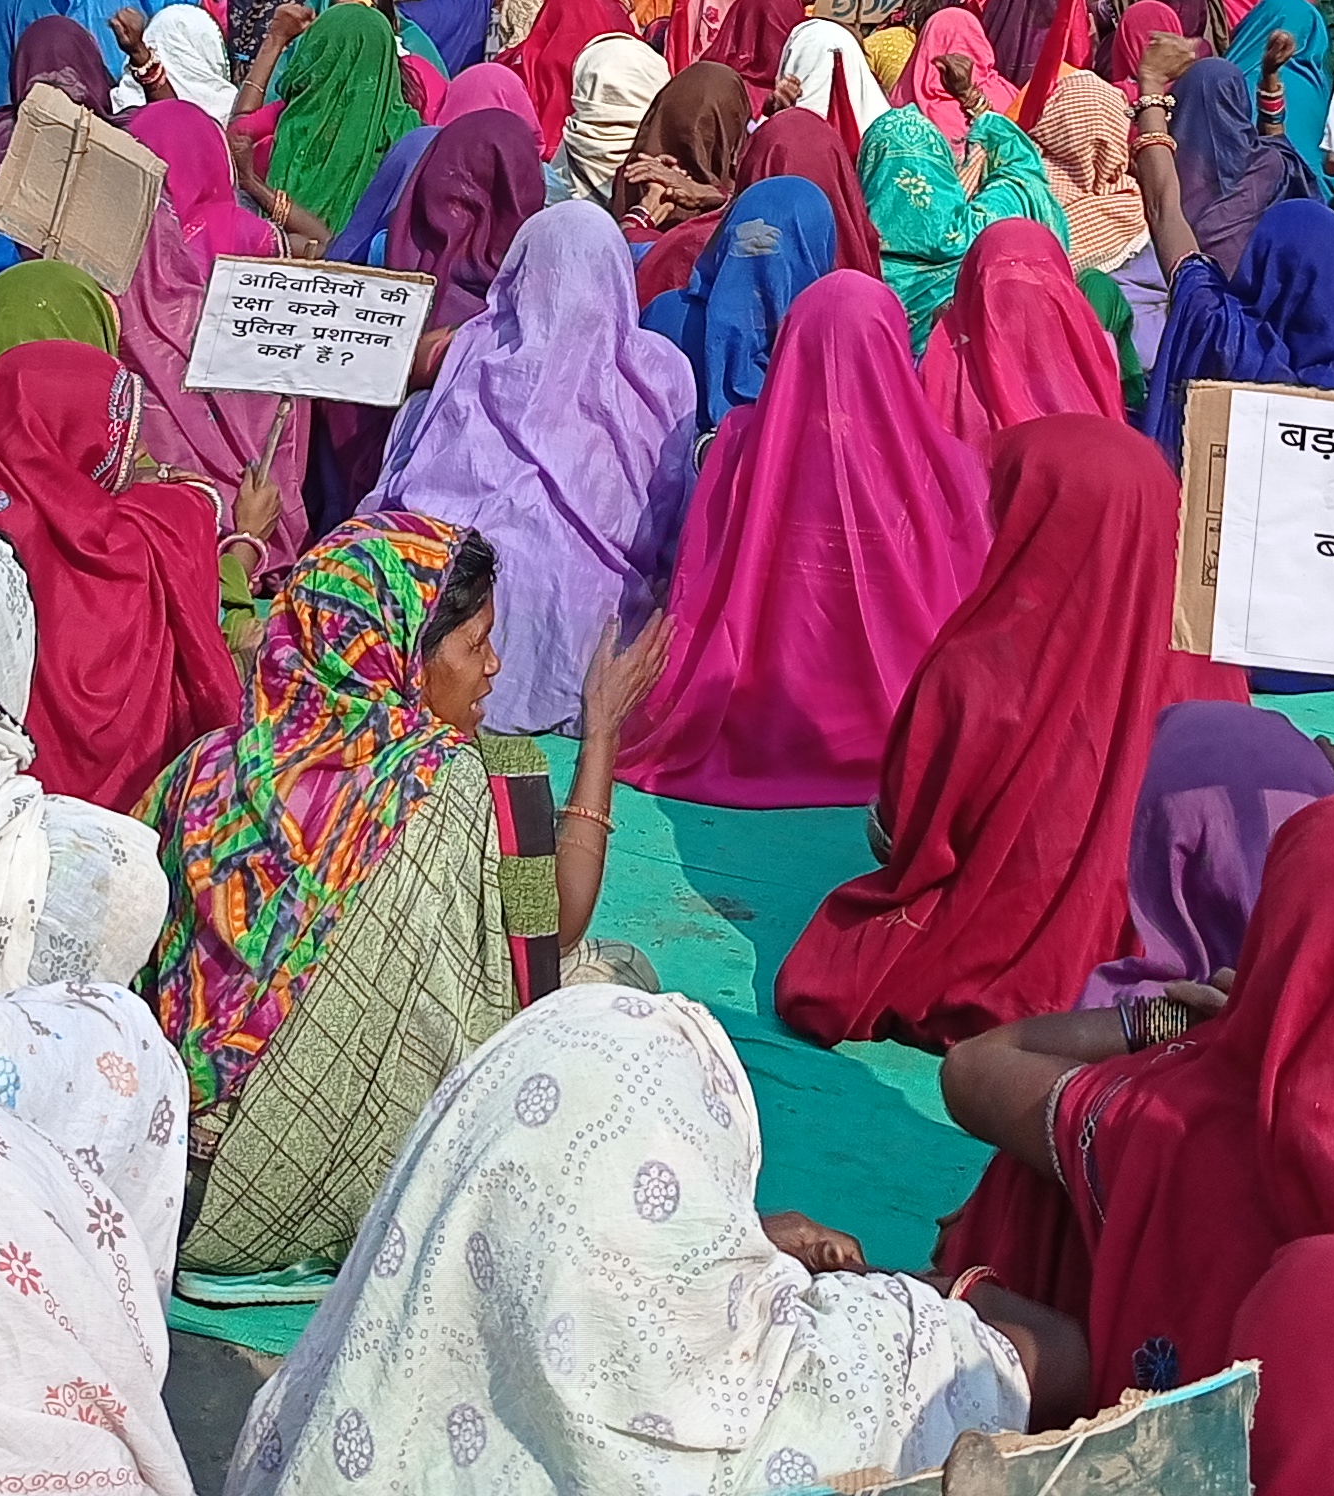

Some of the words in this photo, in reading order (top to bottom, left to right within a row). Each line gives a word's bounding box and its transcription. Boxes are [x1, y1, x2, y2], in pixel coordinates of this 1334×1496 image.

[238, 270, 366, 299] आदिवासियों
[380, 287, 411, 306] की
[231, 295, 274, 313] रक्षा
[287, 299, 340, 318] करने
[355, 307, 406, 328] वाला
[231, 316, 297, 338] पुलिस
[312, 326, 393, 348] प्रशासन
[257, 342, 305, 360] कहाँ
